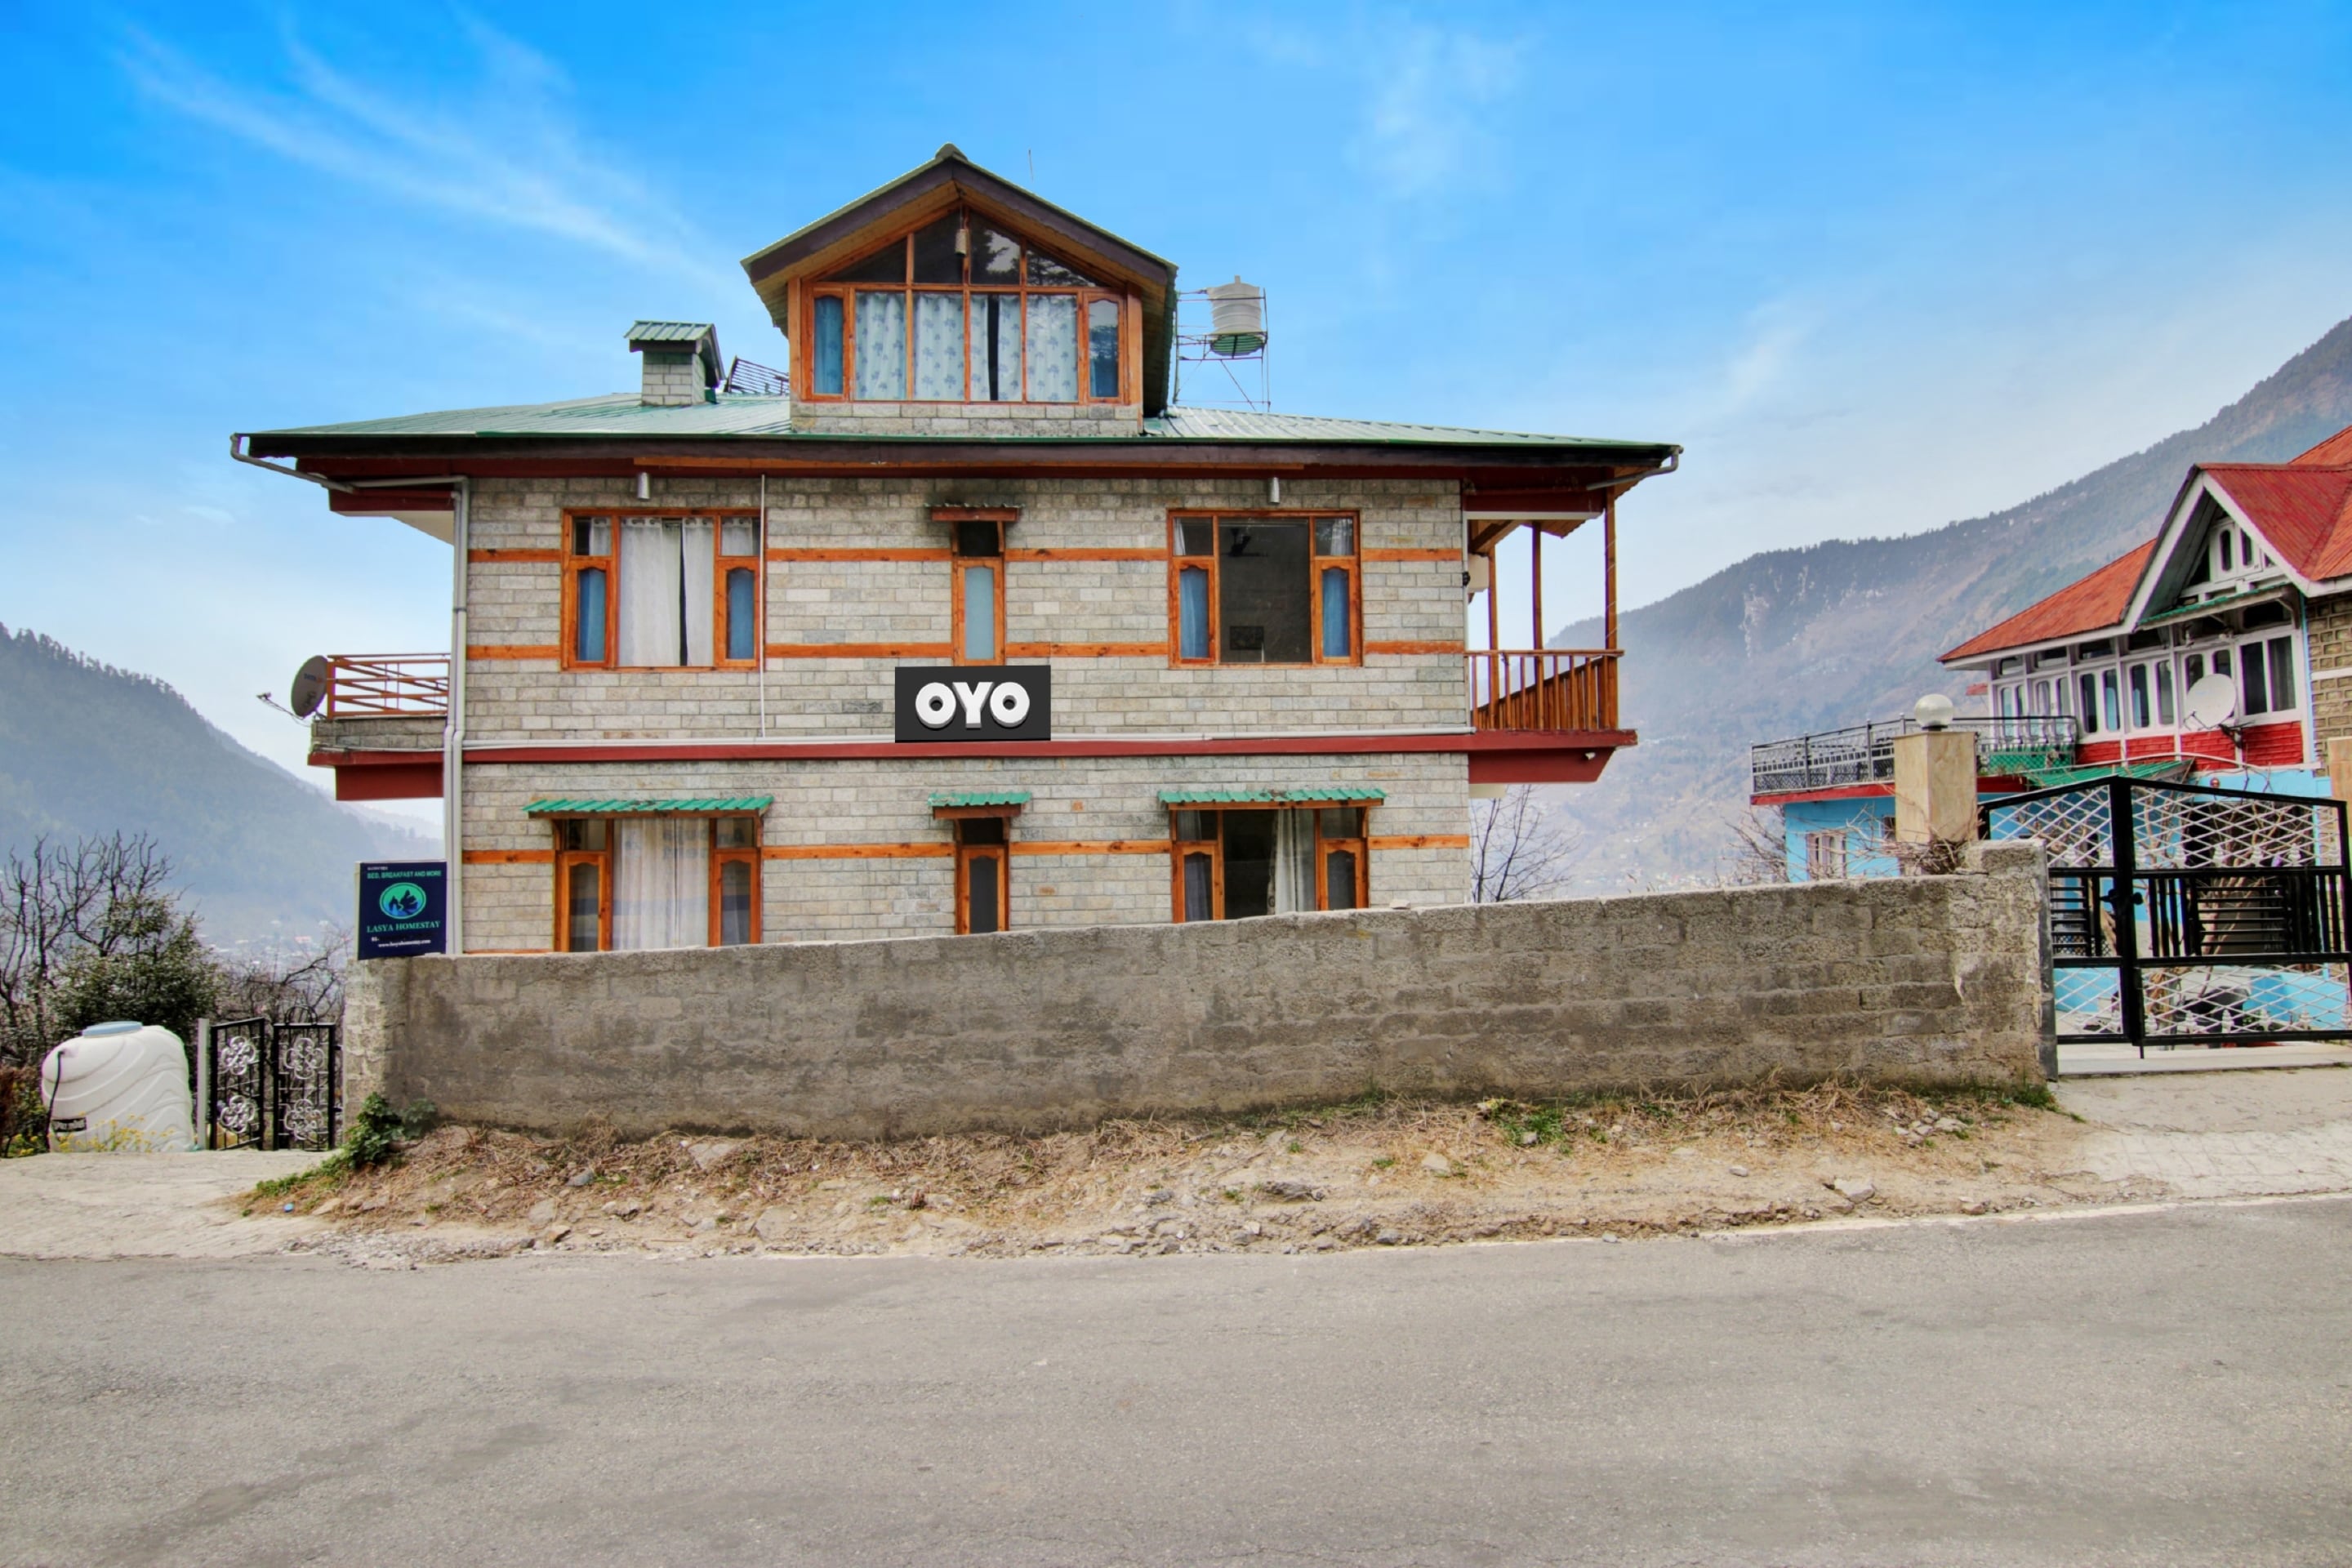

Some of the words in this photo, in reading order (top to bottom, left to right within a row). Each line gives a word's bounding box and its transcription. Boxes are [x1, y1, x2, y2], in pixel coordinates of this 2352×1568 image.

[915, 682, 1030, 728] OYO
[381, 871, 413, 879] BREAKFAST
[367, 924, 394, 933] LASYA
[395, 920, 440, 930] HOMESTAY
